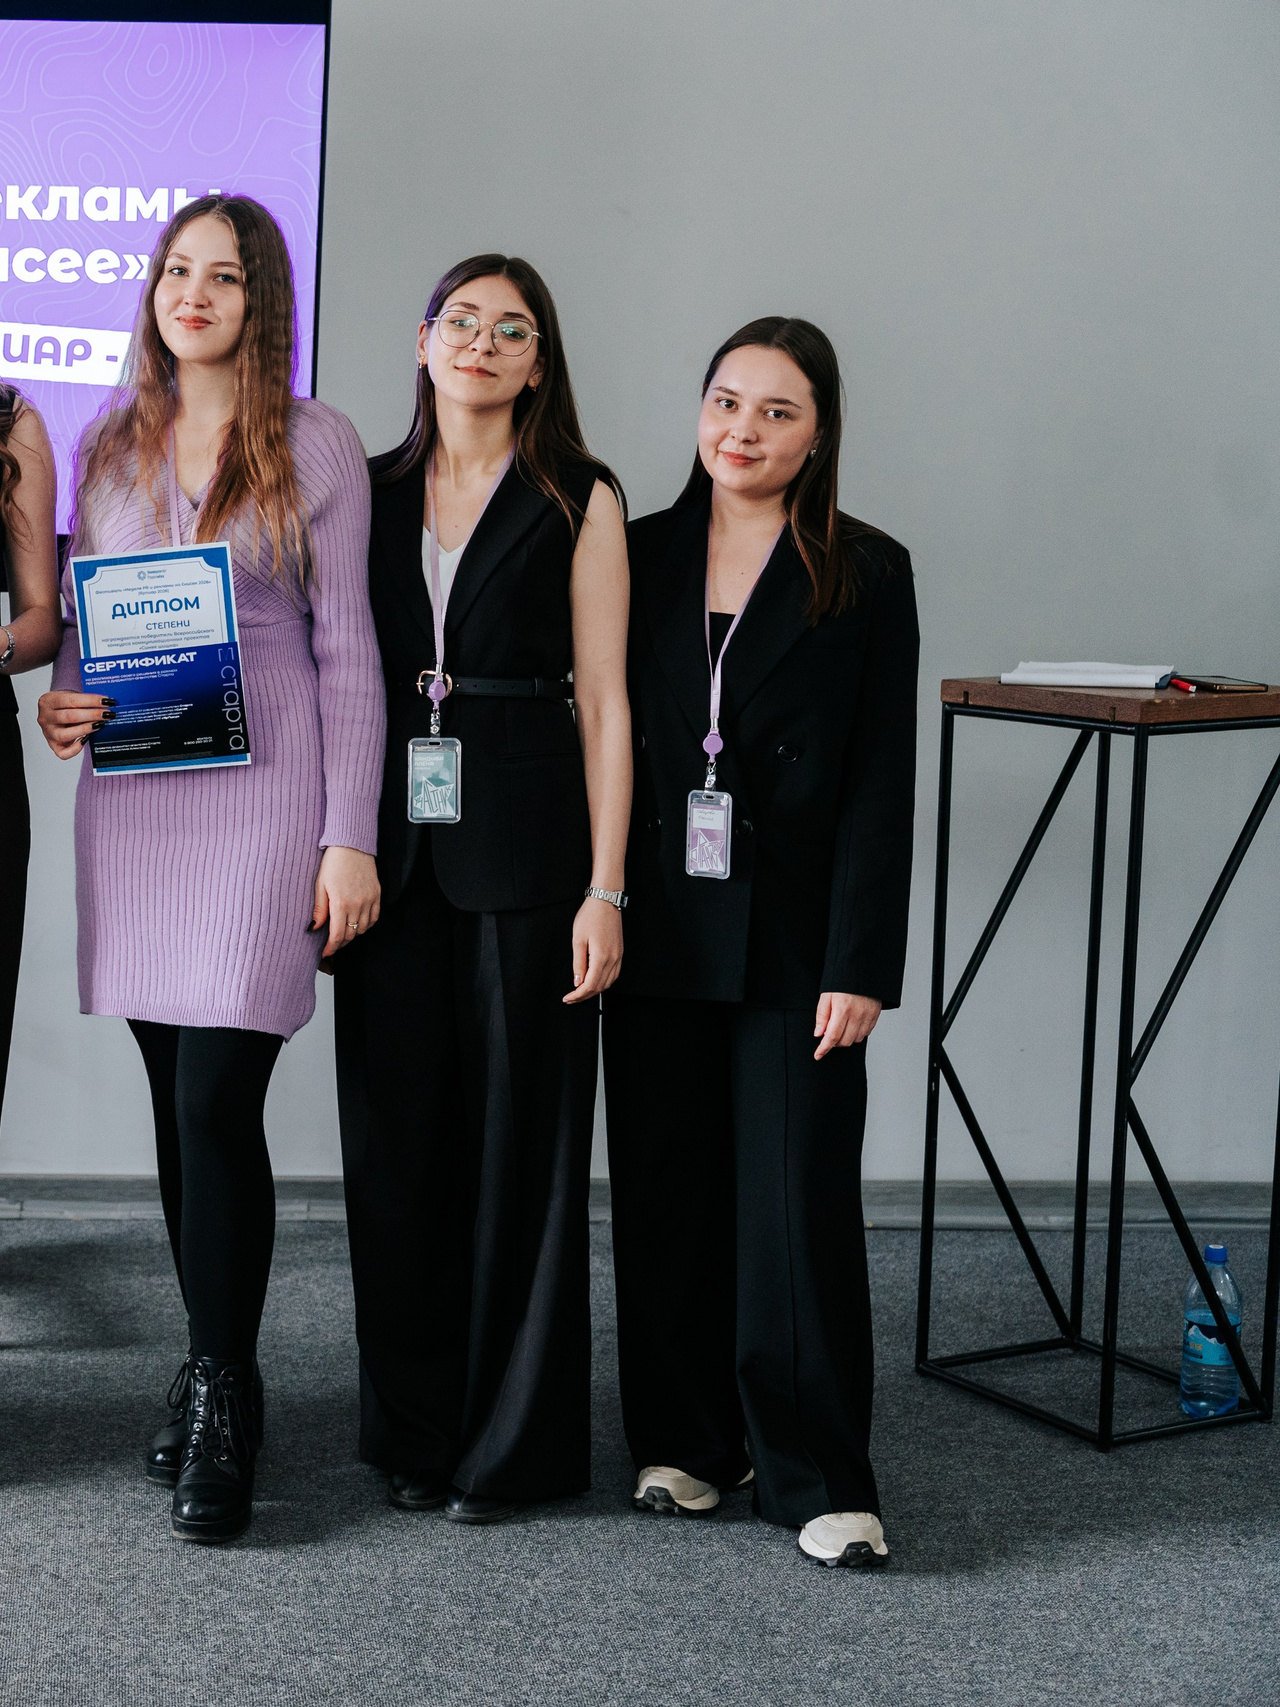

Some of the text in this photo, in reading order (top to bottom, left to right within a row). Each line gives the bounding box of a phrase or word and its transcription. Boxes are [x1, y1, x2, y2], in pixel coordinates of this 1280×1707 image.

[111, 595, 201, 620] ДИПЛОМ
[145, 619, 191, 631] СТЕПЕНИ
[83, 651, 198, 674] СЕРТИФИКАТ
